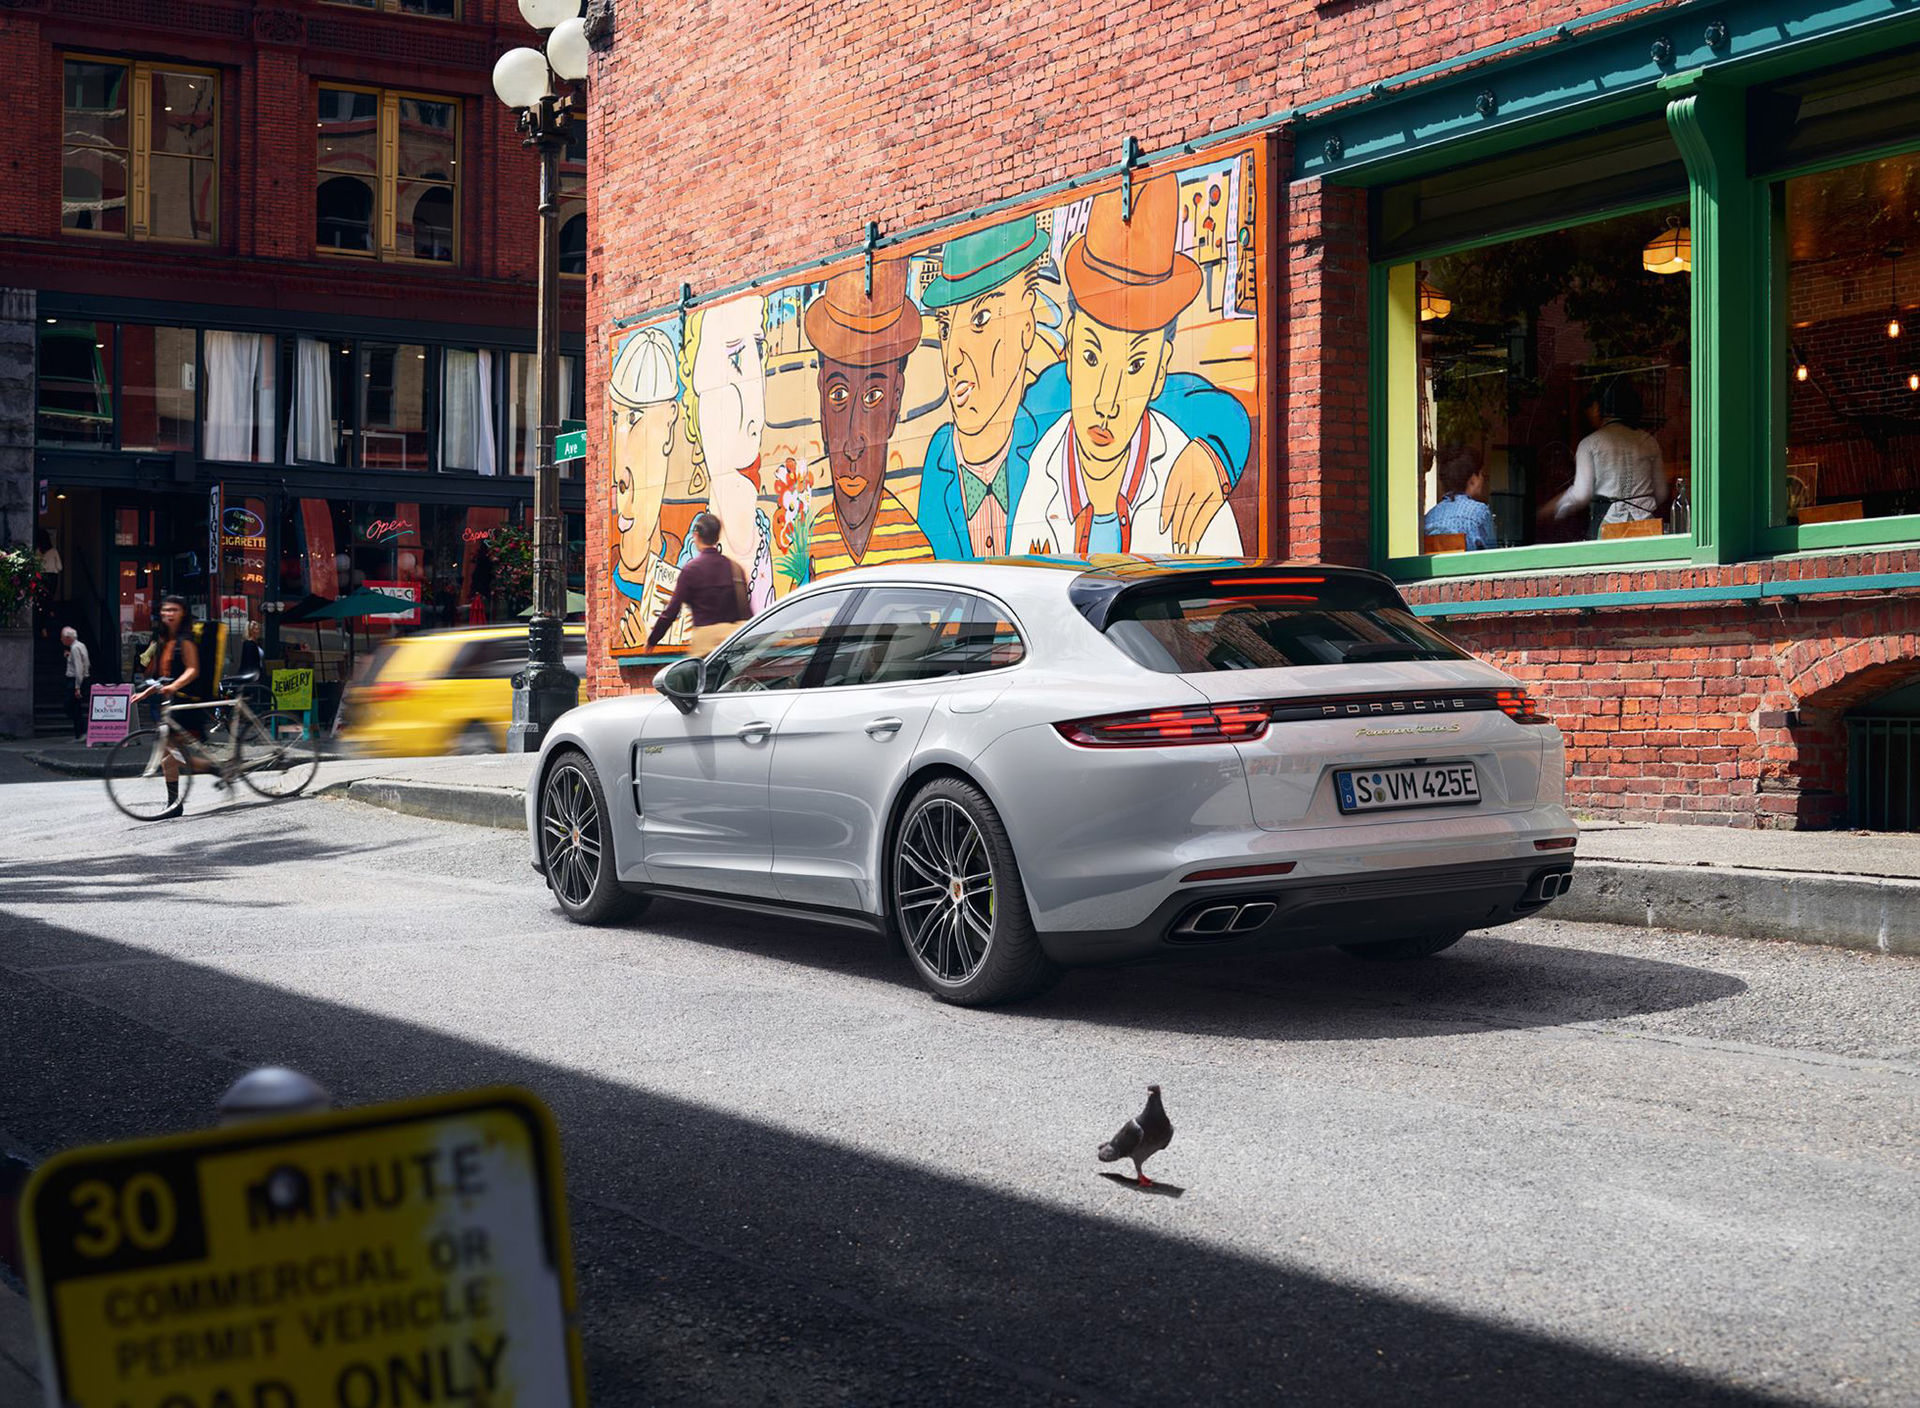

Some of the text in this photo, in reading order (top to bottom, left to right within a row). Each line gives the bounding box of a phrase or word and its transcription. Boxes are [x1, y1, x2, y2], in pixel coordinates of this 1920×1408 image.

[564, 442, 578, 456] Ave
[209, 492, 219, 570] CIGARS
[366, 519, 412, 539] Open
[274, 671, 311, 693] JEWELRY
[1322, 699, 1464, 715] PORSCHE
[1355, 726, 1414, 738] Panamera
[1356, 776, 1372, 803] S
[1386, 772, 1418, 801] VM
[1422, 768, 1477, 799] 425E
[70, 1171, 177, 1258] 30
[105, 1225, 491, 1329] COMMERCIAL OR
[116, 1276, 491, 1382] PERMIT VEHICLE
[335, 1330, 509, 1408] ONLY
